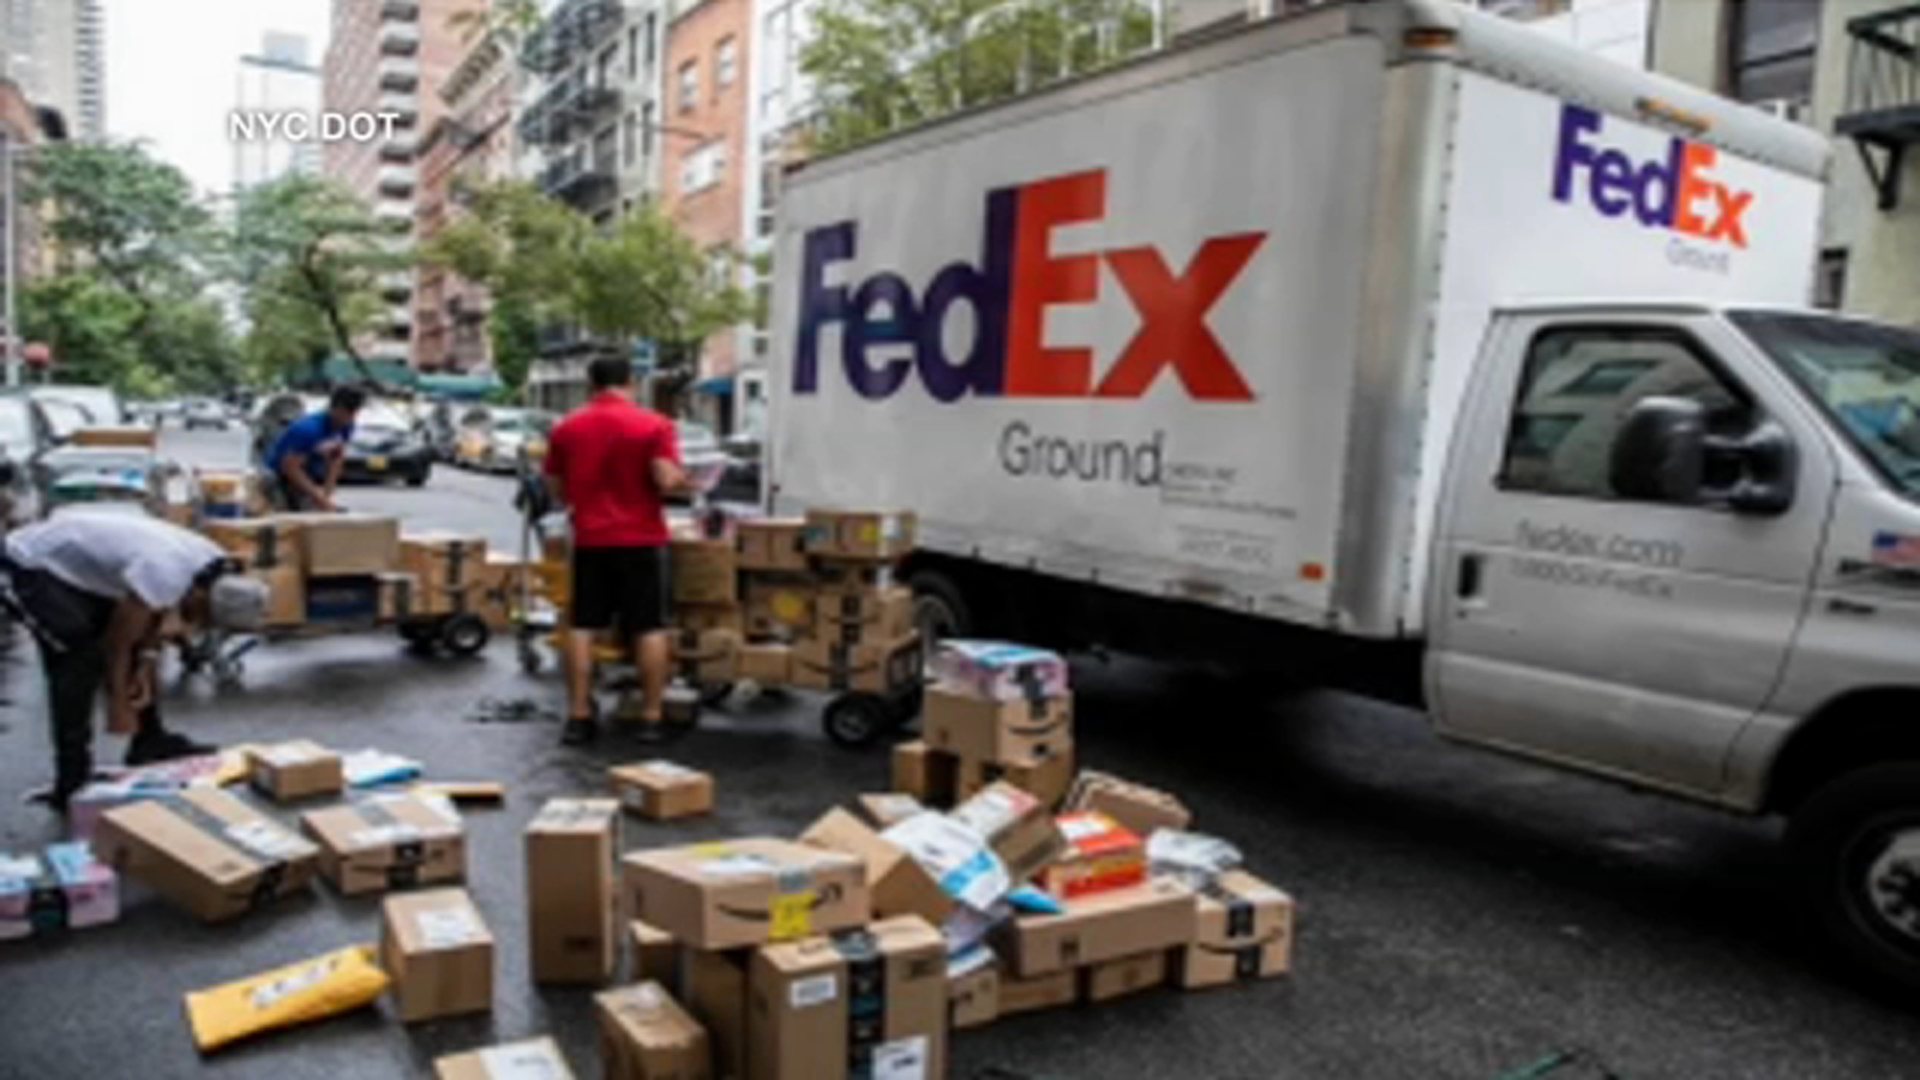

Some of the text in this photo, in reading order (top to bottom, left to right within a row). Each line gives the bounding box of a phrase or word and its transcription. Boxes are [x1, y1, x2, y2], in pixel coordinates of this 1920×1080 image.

[1553, 104, 1753, 249] FedEx
[792, 169, 1268, 402] FedEx
[1000, 421, 1164, 486] Ground
